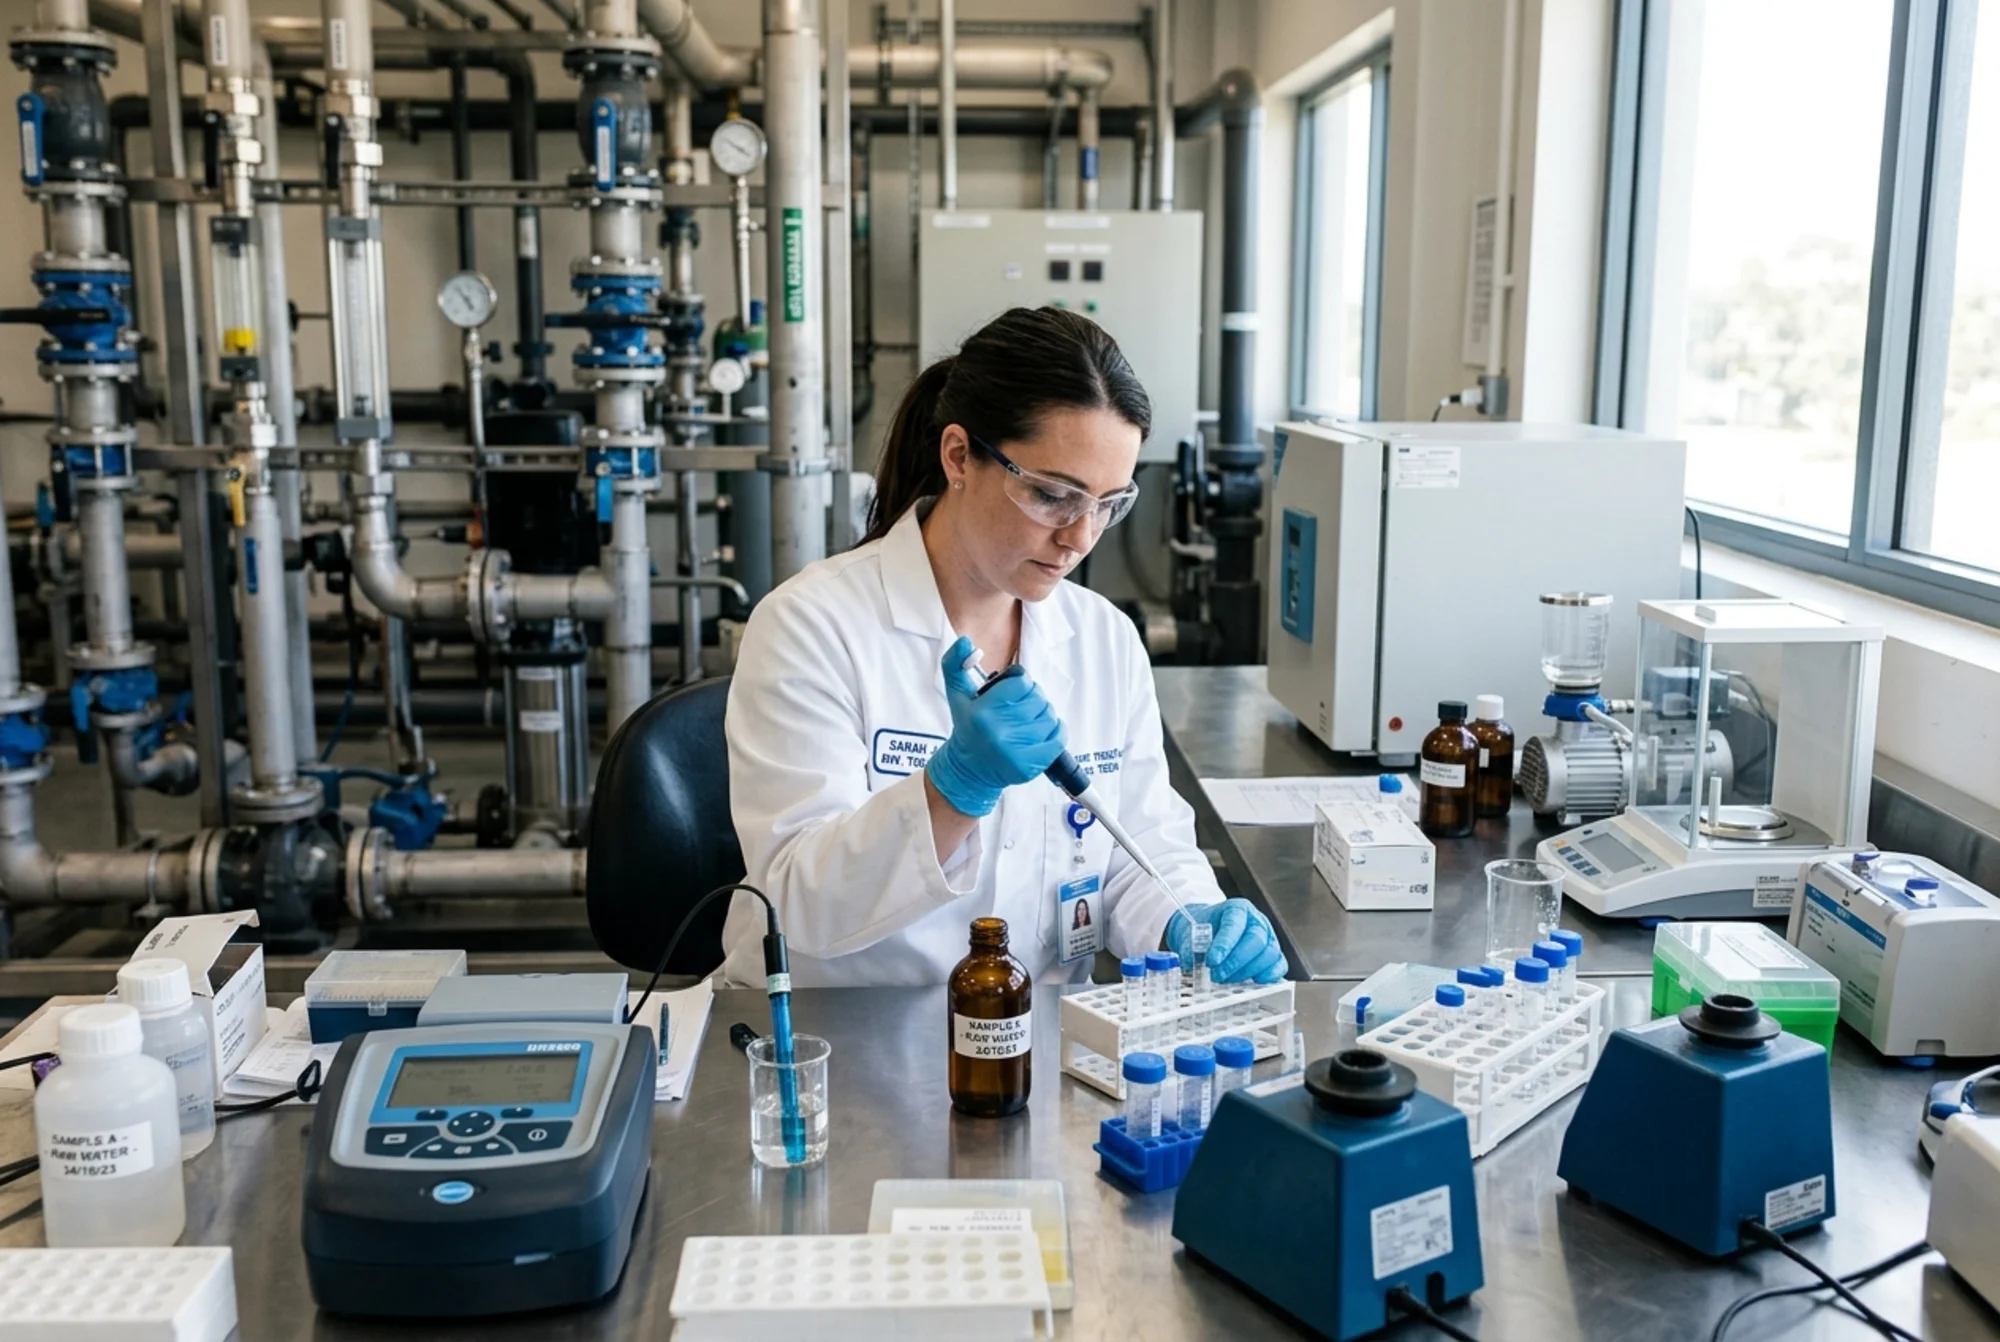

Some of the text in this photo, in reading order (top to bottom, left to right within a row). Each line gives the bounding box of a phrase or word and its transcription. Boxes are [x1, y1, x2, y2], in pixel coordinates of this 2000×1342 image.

[889, 740, 927, 754] SARAH
[108, 1134, 117, 1144] A
[80, 1146, 129, 1161] WATER
